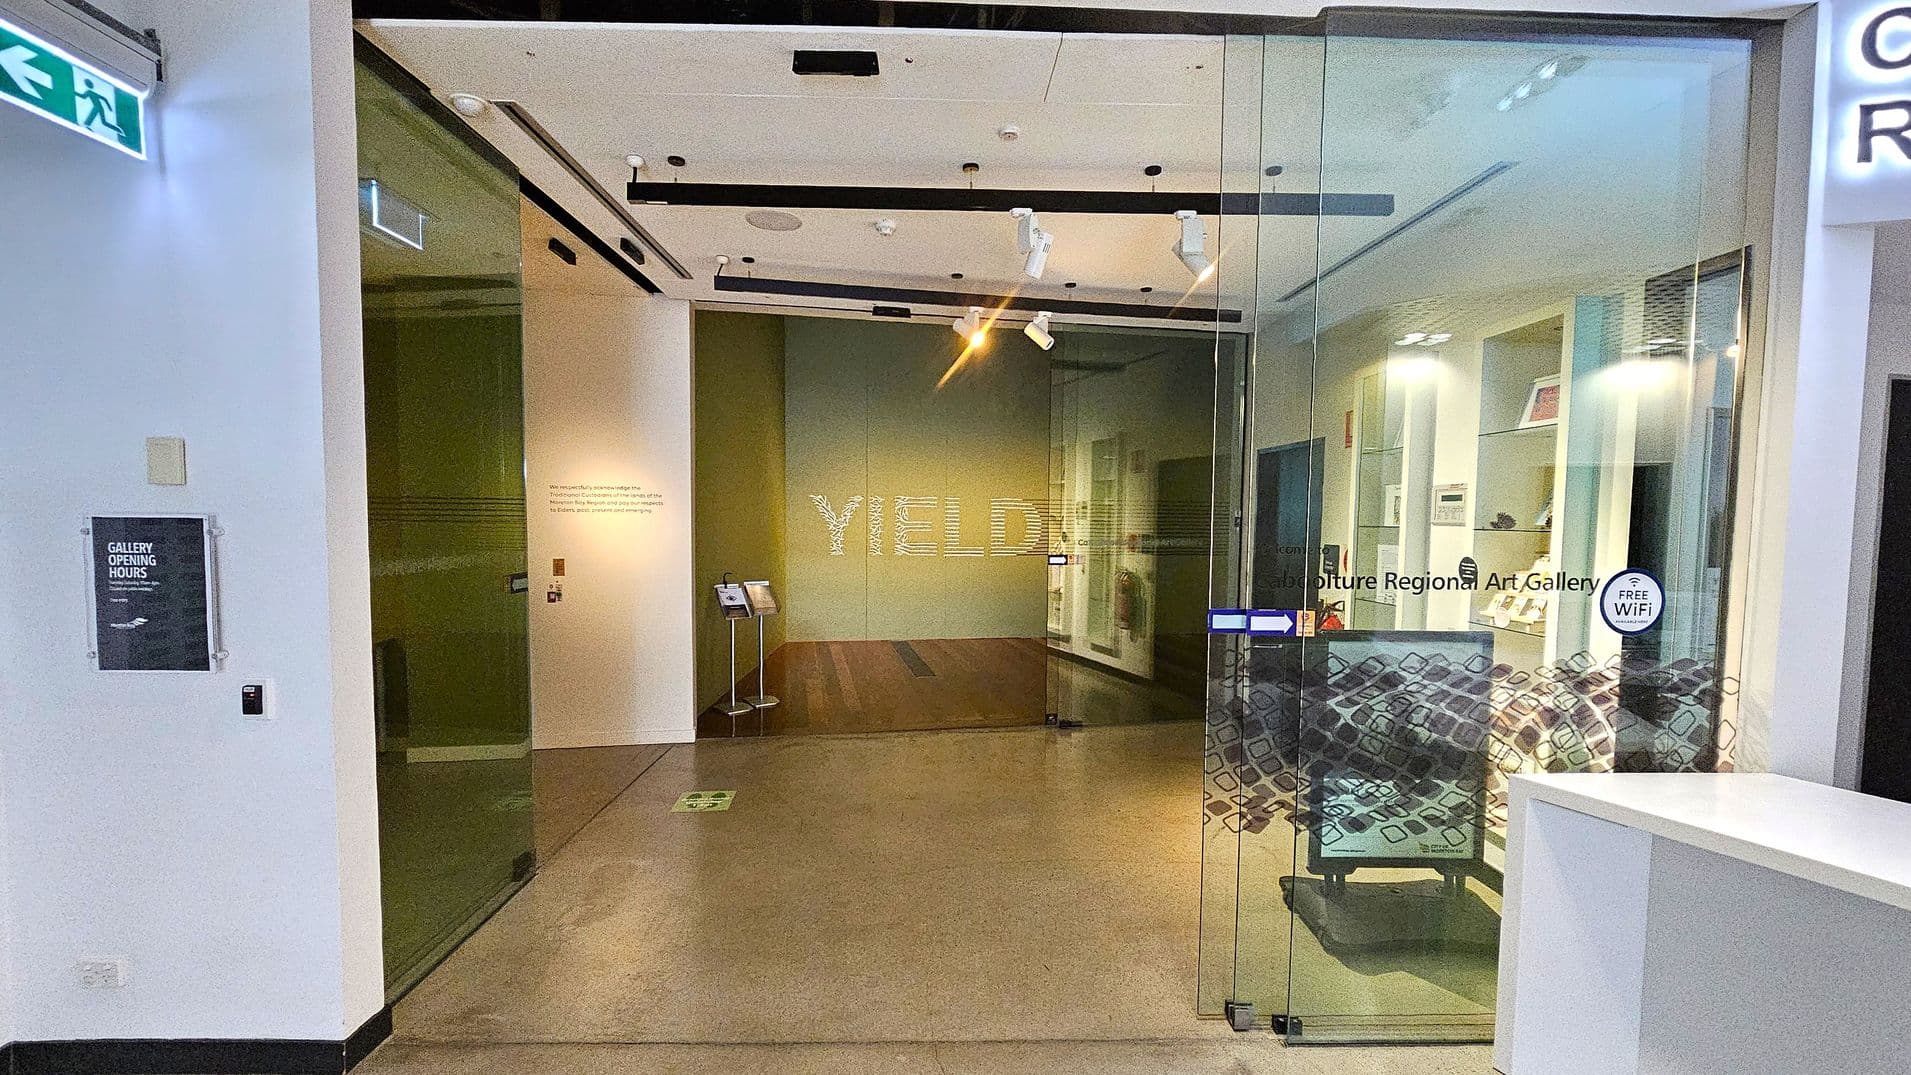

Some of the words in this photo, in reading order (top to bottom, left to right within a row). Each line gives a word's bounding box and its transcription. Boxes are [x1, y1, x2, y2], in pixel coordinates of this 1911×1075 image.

[809, 494, 1042, 557] YIELD
[107, 542, 153, 554] GALLERY
[108, 554, 157, 566] OPENING
[109, 567, 147, 579] HOURS
[1257, 570, 1377, 590] aboolture
[1385, 572, 1478, 595] Regional
[1485, 573, 1519, 591] Art
[1527, 572, 1600, 596] Gallery
[1618, 590, 1649, 600] FREE
[1614, 602, 1652, 616] WiFi
